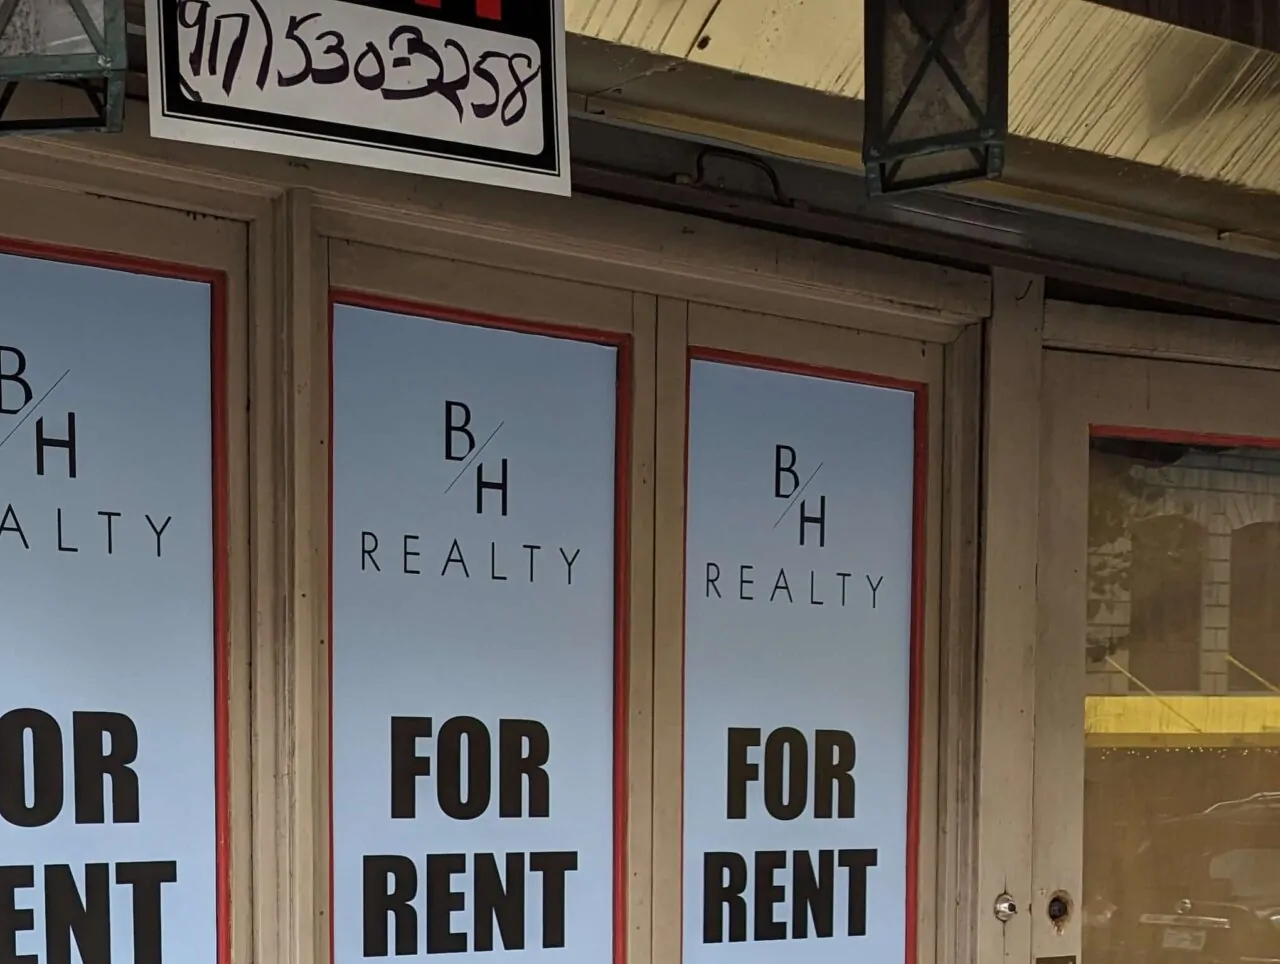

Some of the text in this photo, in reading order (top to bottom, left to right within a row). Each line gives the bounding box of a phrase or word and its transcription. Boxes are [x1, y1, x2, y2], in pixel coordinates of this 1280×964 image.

[362, 531, 580, 585] REALTY
[706, 562, 883, 608] REALTY
[391, 716, 550, 820] FOR
[726, 727, 856, 821] FOR
[363, 851, 578, 957] RENT
[703, 848, 878, 944] RENT
